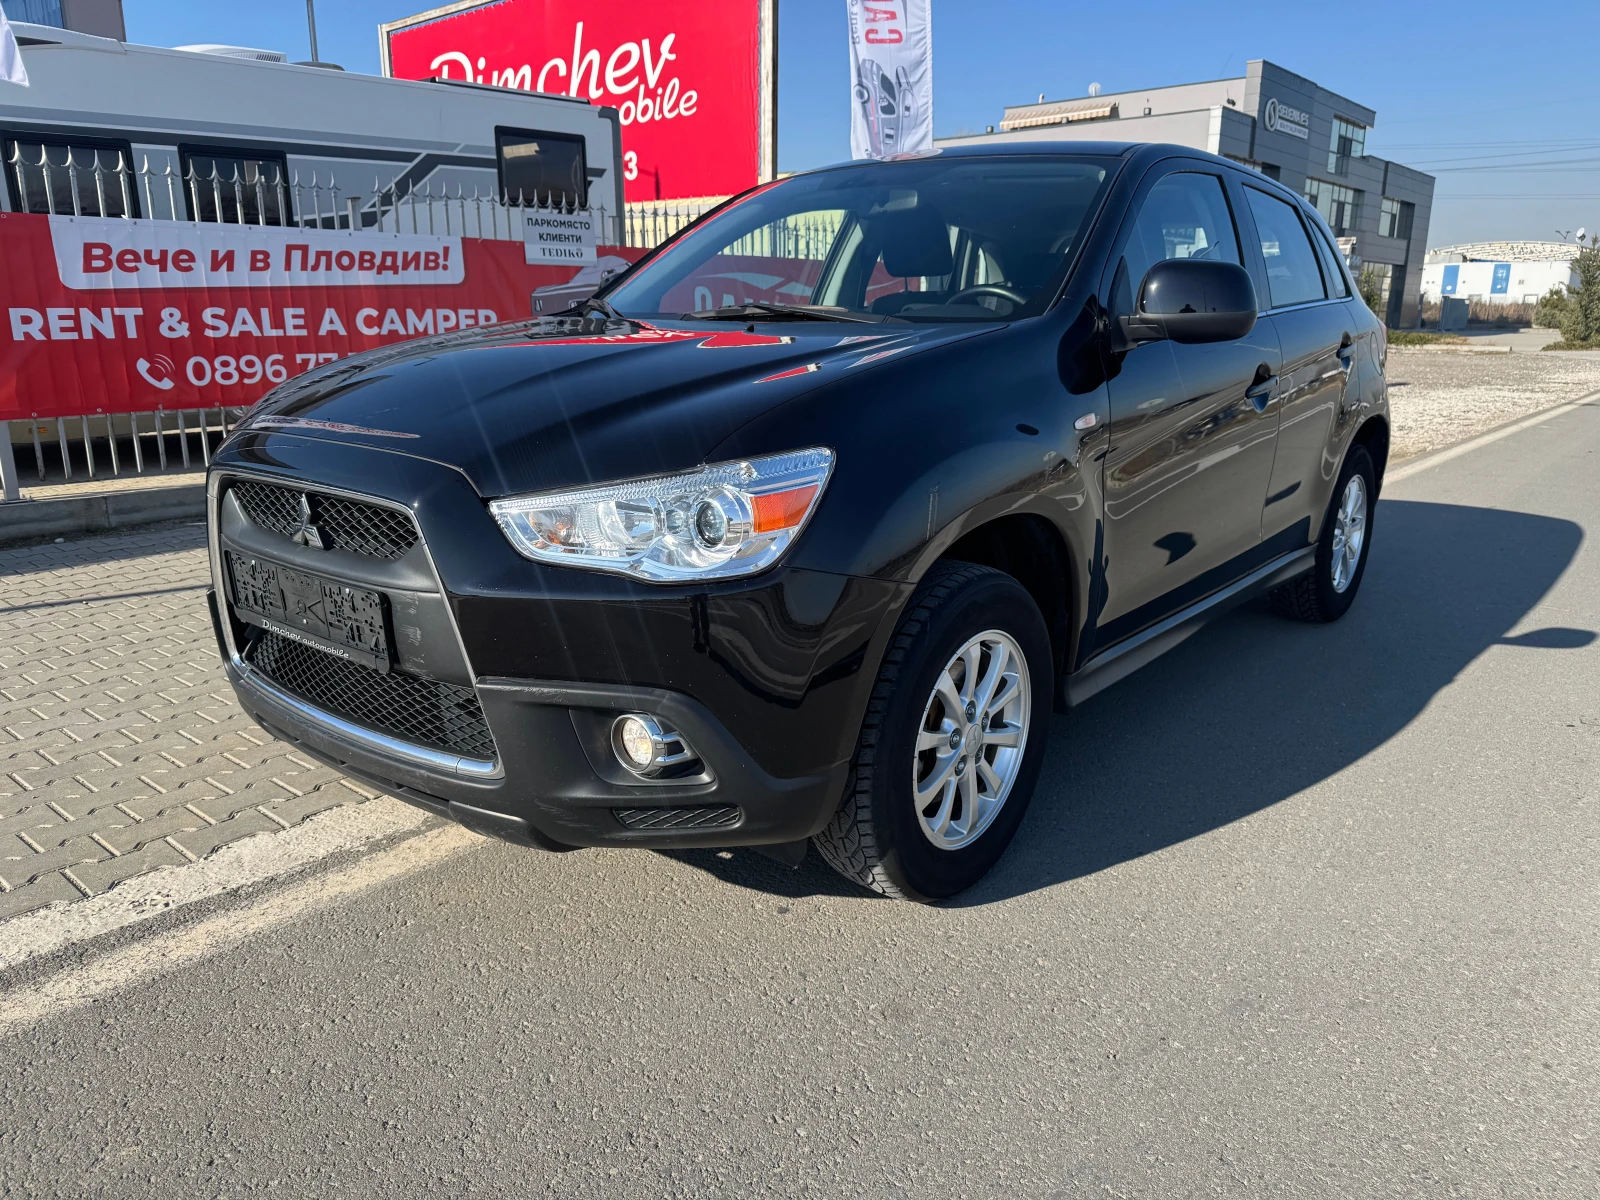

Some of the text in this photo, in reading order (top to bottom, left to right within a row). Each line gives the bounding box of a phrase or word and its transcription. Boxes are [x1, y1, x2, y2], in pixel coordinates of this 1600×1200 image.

[430, 22, 677, 99] Dimchev
[526, 217, 591, 230] ПАРКОМЯСТО
[538, 232, 582, 244] КЛИЕНТИ
[82, 241, 451, 276] Вече и в Пловдив!
[540, 247, 583, 259] TEDIKO
[8, 307, 144, 341] RENT
[158, 306, 191, 339] &
[202, 306, 308, 337] SALE
[317, 307, 348, 336] A
[185, 354, 288, 387] 0896
[261, 618, 350, 659] Dimchev automobile
